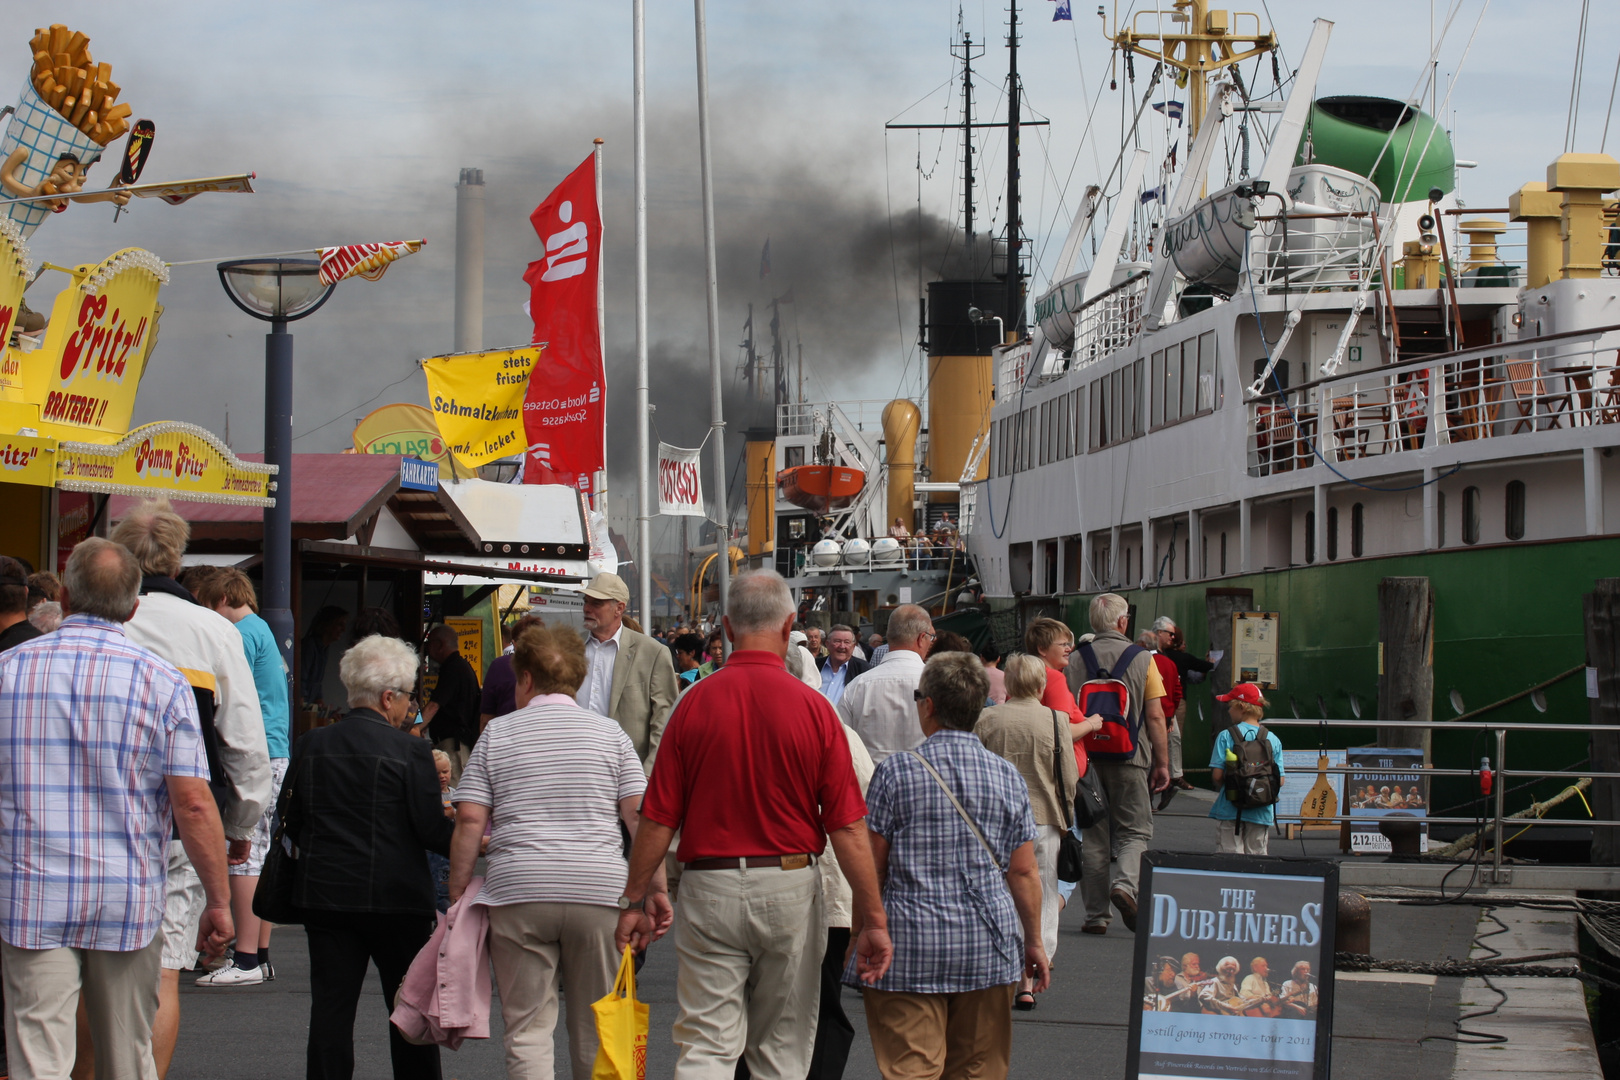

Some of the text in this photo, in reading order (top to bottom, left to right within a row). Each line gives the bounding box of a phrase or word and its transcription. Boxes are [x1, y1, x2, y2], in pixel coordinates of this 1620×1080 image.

[60, 293, 147, 380] Fritz"
[503, 356, 531, 369] stets
[43, 390, 99, 425] BRATEREI
[402, 461, 438, 487] FAHRKARTEN
[1379, 759, 1393, 768] THE
[1220, 888, 1256, 910] THE
[1175, 1029, 1206, 1043] going
[1260, 1034, 1284, 1044] tour
[1286, 1036, 1311, 1046] 2011
